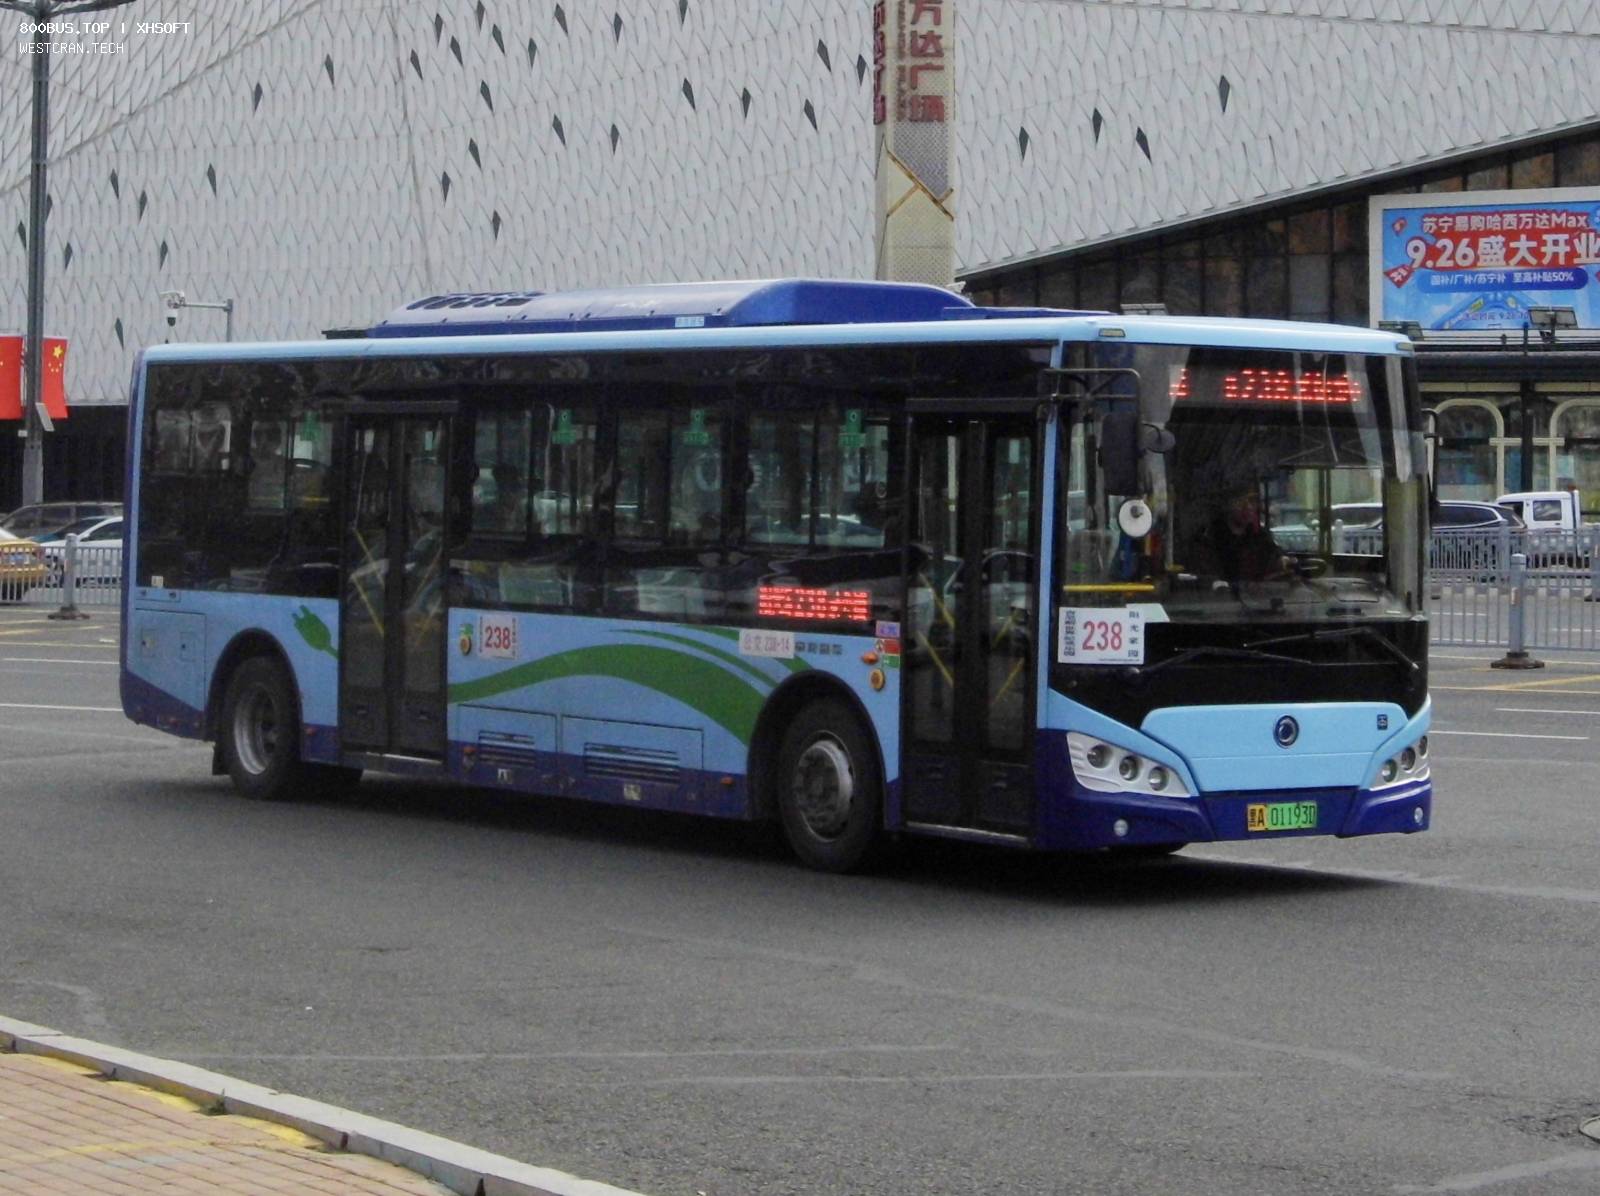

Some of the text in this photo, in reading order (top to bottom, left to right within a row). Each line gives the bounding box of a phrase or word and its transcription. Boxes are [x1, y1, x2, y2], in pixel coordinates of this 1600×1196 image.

[1406, 231, 1600, 269] 9.26盛大开业
[484, 625, 511, 650] 238
[1081, 620, 1123, 651] 238
